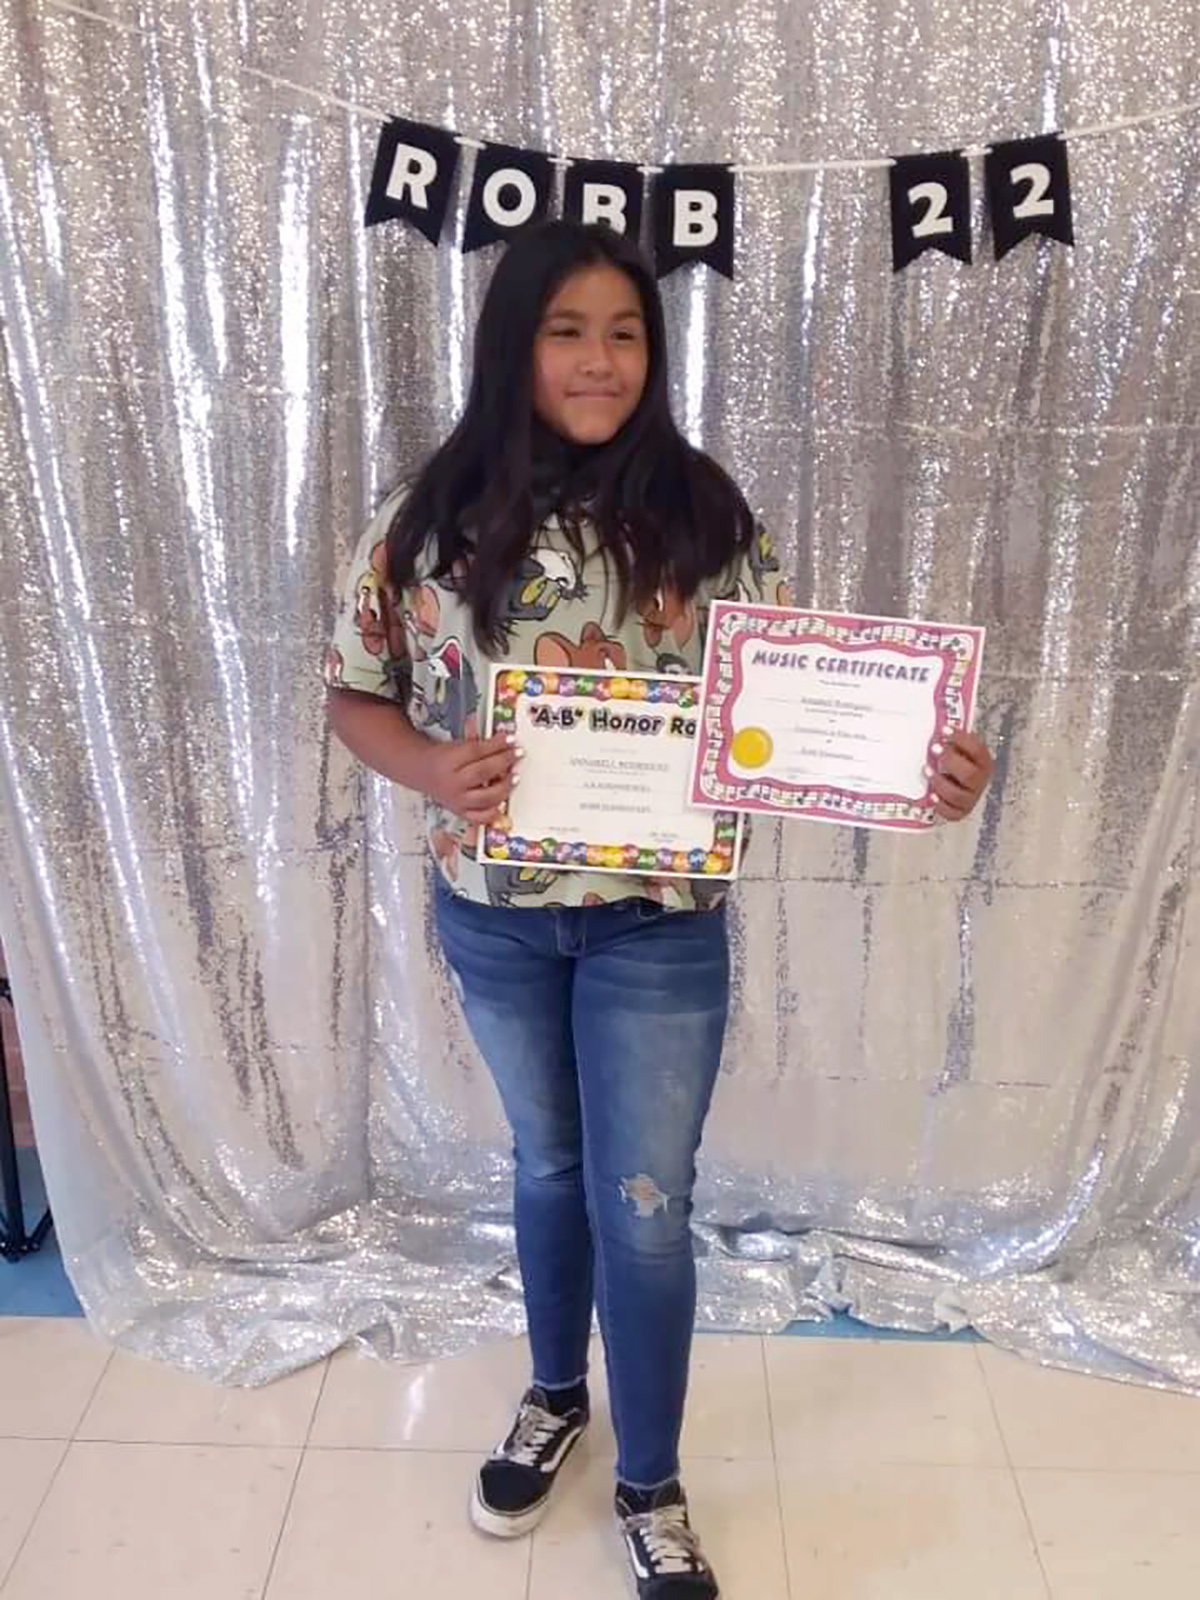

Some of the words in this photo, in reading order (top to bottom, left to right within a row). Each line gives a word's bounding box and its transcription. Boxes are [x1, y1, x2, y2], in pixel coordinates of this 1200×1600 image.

[385, 144, 719, 248] ROBB
[907, 163, 1055, 237] 22
[752, 650, 808, 669] MUSIC
[816, 657, 930, 682] CERTIFICATE
[591, 708, 664, 733] Honor
